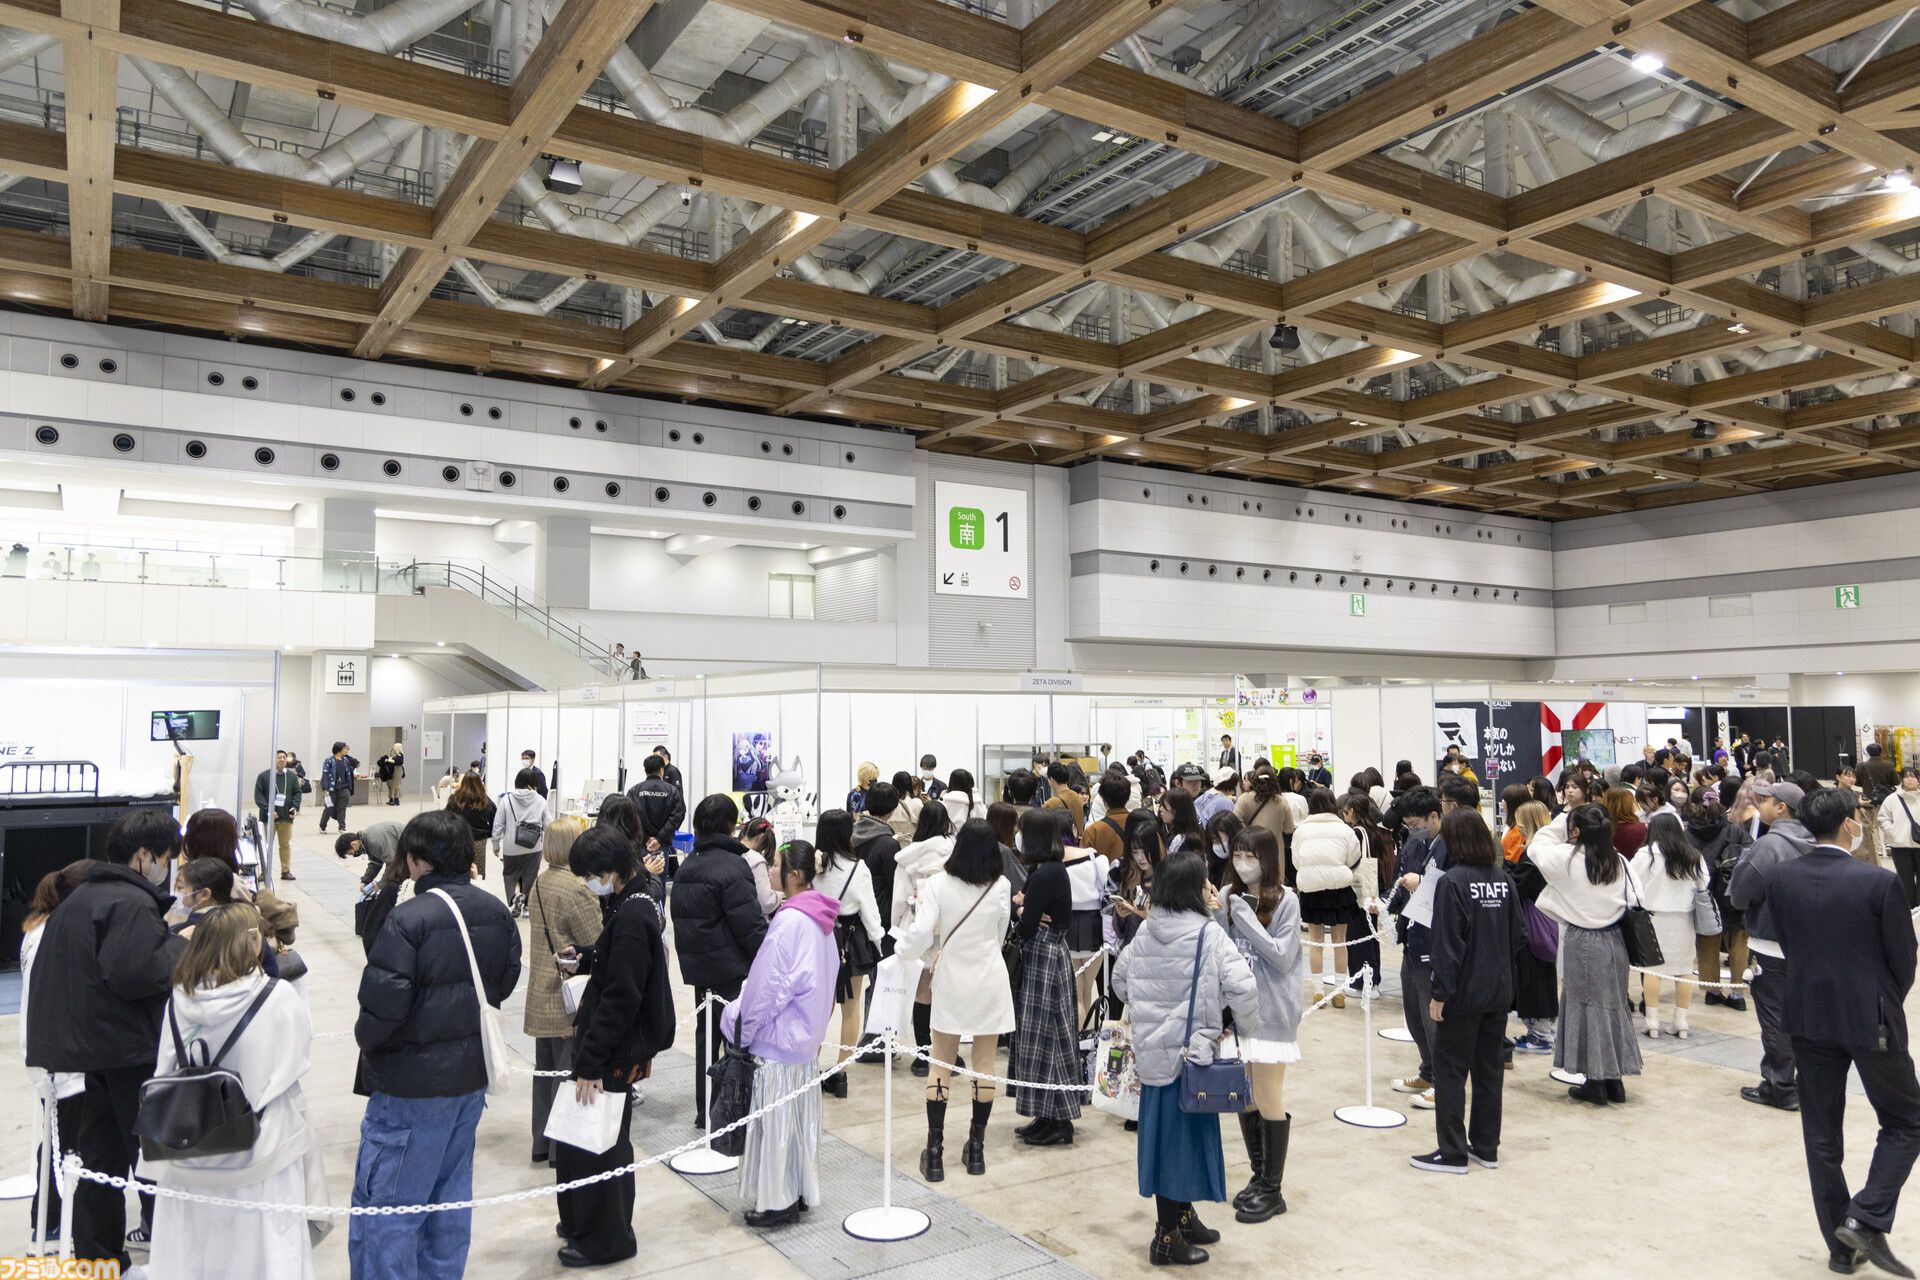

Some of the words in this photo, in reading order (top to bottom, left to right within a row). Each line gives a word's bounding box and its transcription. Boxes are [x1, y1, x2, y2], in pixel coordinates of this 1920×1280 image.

[957, 511, 976, 521] South
[959, 522, 975, 546] 南
[995, 511, 1009, 553] 1
[1048, 678, 1072, 686] DIVISION
[1469, 881, 1509, 900] STAFF
